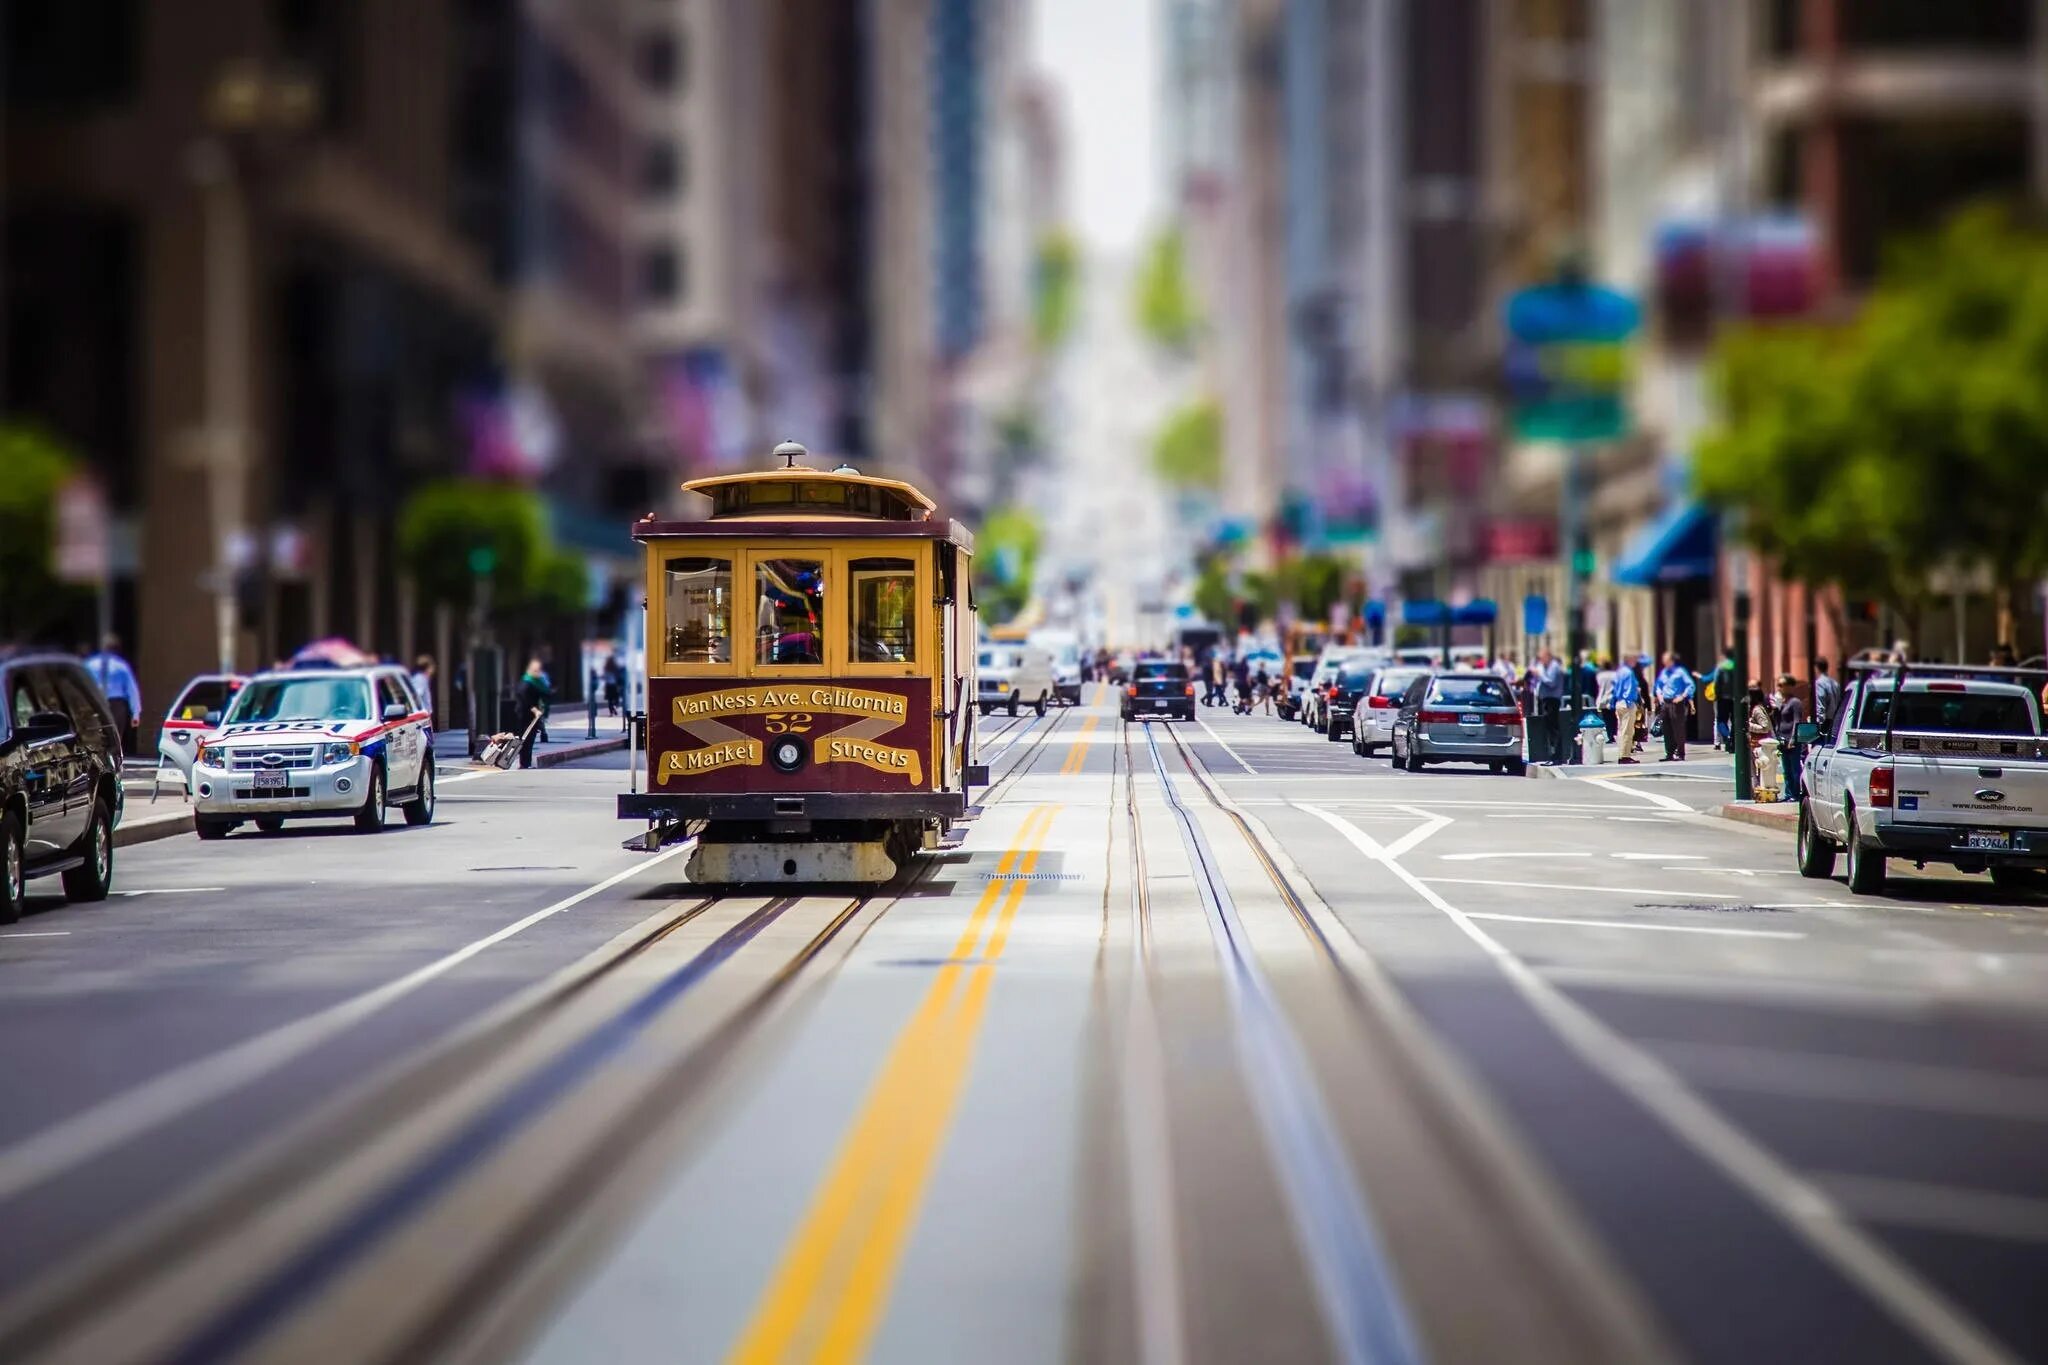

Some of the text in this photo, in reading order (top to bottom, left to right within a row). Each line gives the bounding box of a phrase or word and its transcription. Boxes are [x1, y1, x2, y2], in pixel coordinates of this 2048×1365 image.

[677, 698, 709, 715] Van
[712, 693, 756, 711] Ness
[811, 689, 905, 715] California
[766, 713, 813, 733] 52
[669, 744, 754, 769] & Market
[830, 741, 908, 767] Streets
